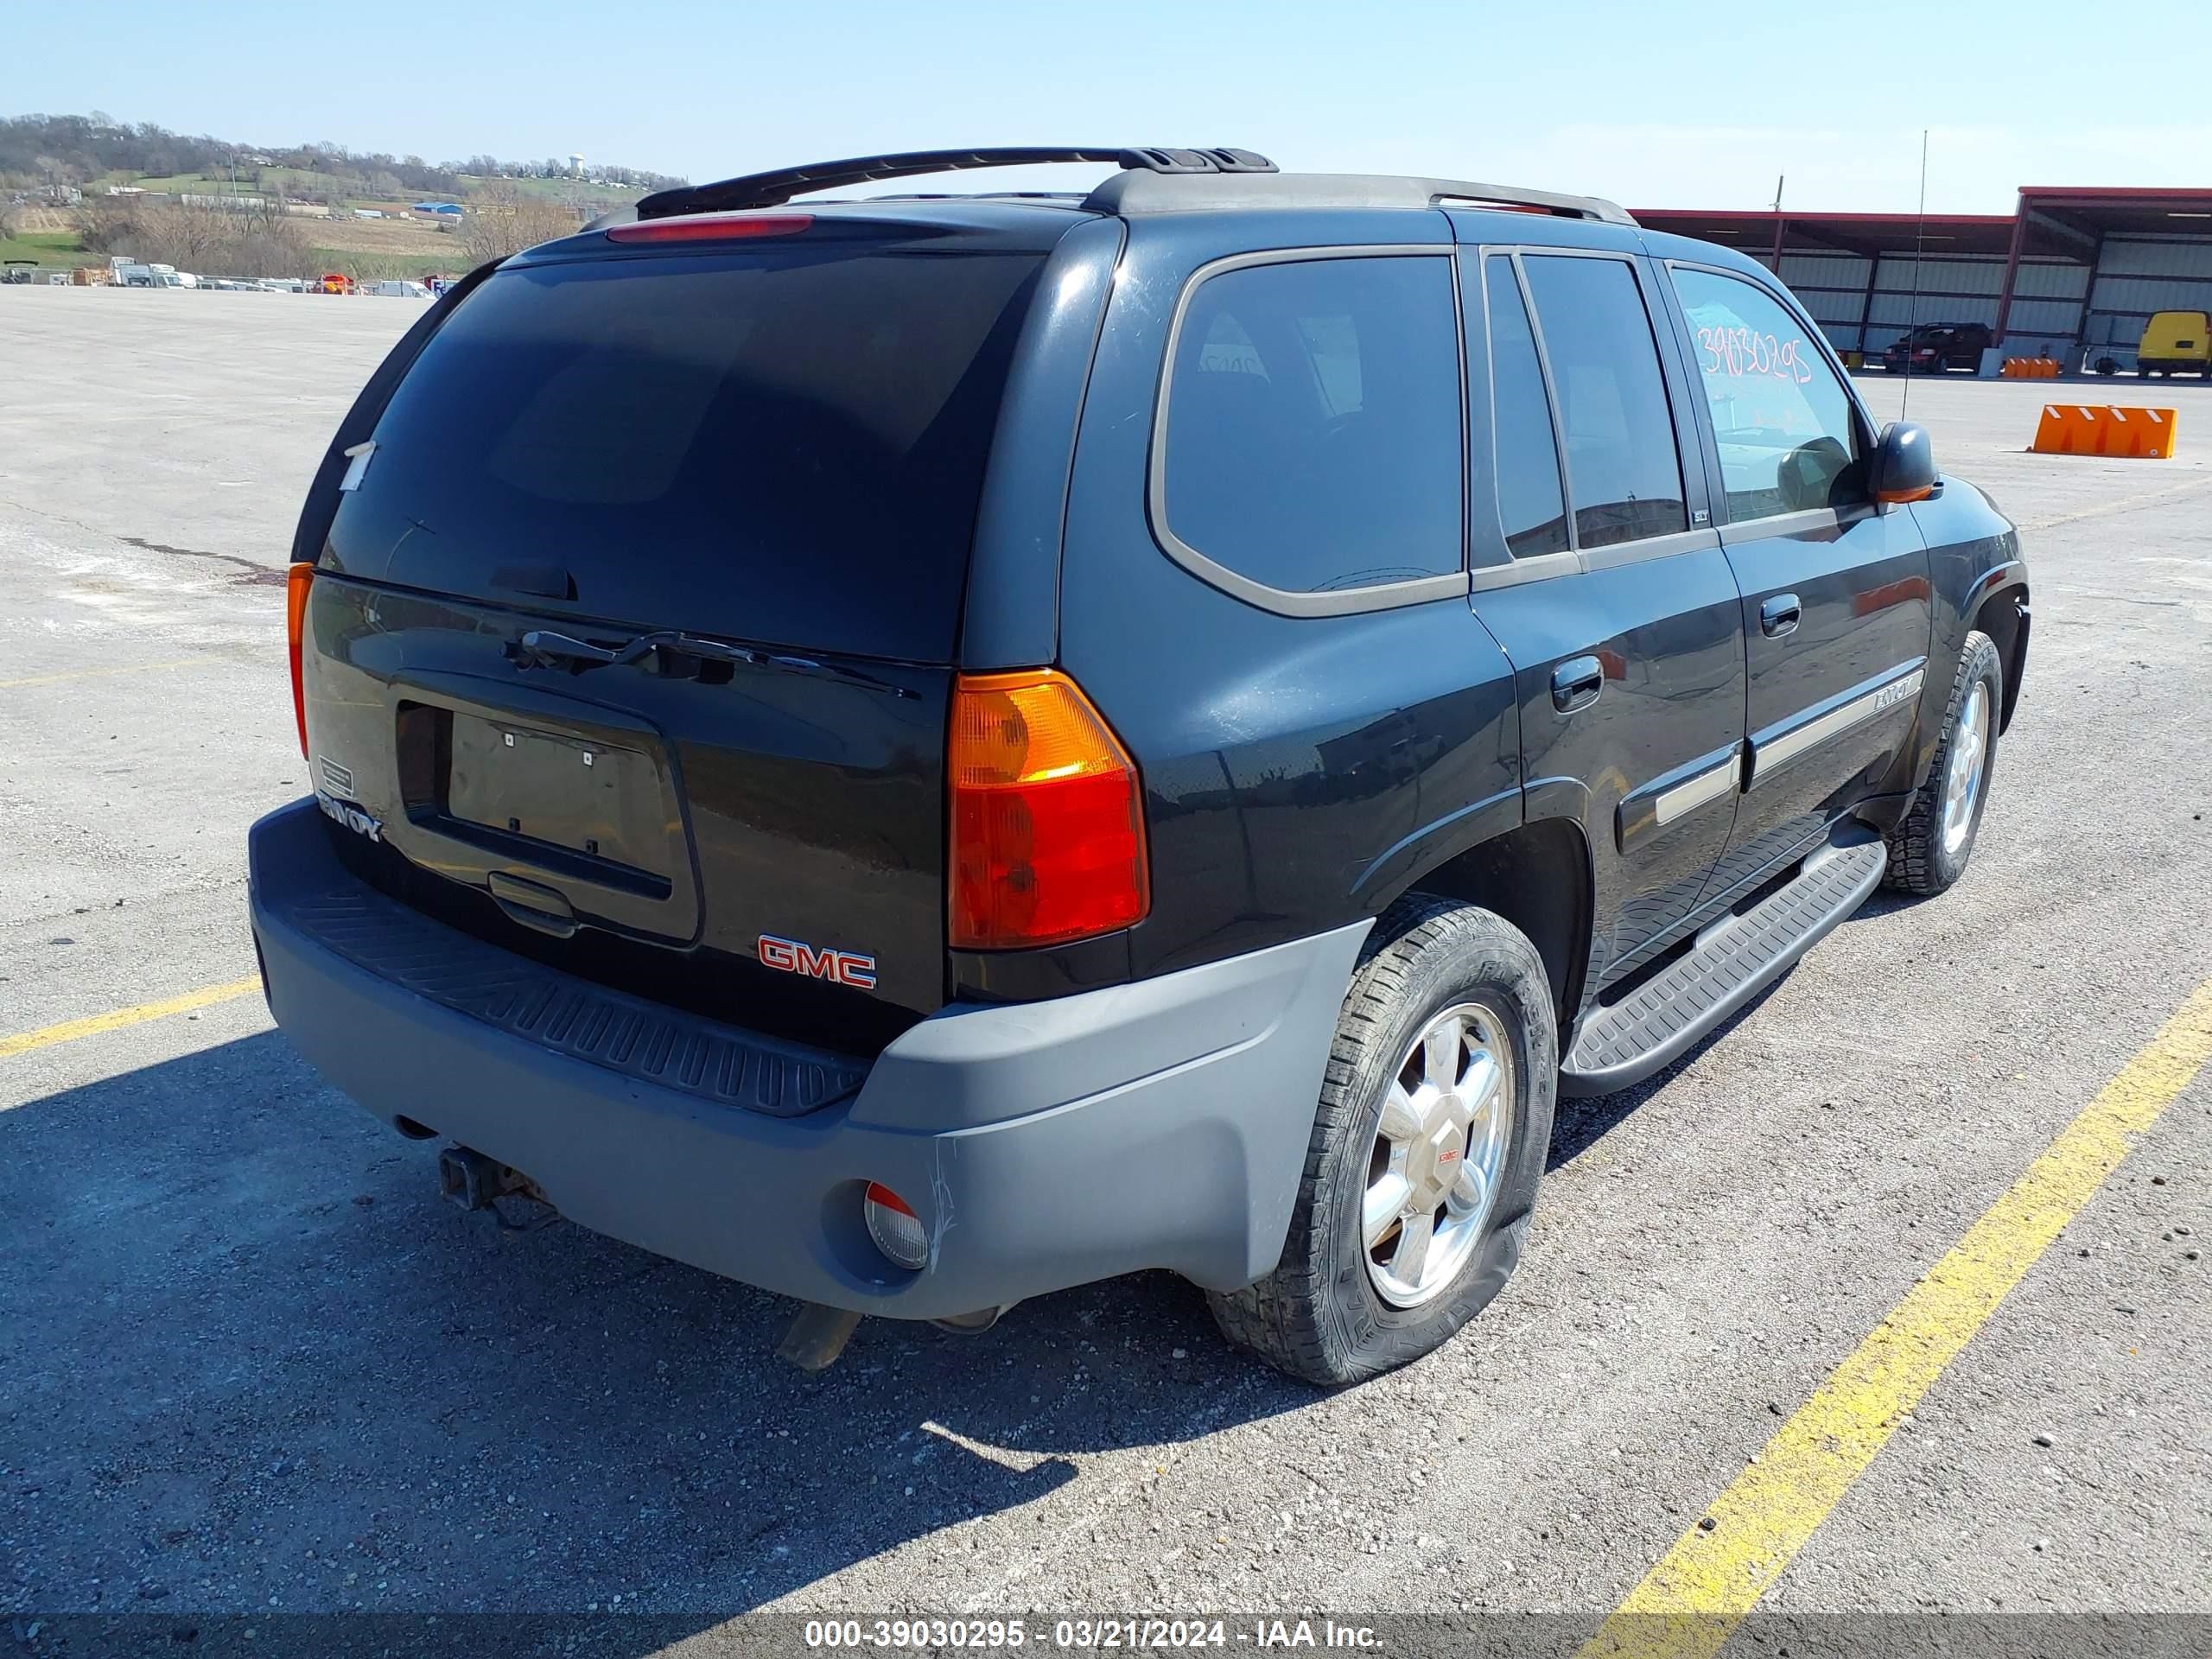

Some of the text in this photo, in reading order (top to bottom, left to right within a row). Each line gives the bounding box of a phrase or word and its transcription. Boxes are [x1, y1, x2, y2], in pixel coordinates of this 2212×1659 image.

[1697, 326, 1812, 384] 39030295
[1694, 512, 1708, 523] SLT
[758, 933, 877, 989] GMC
